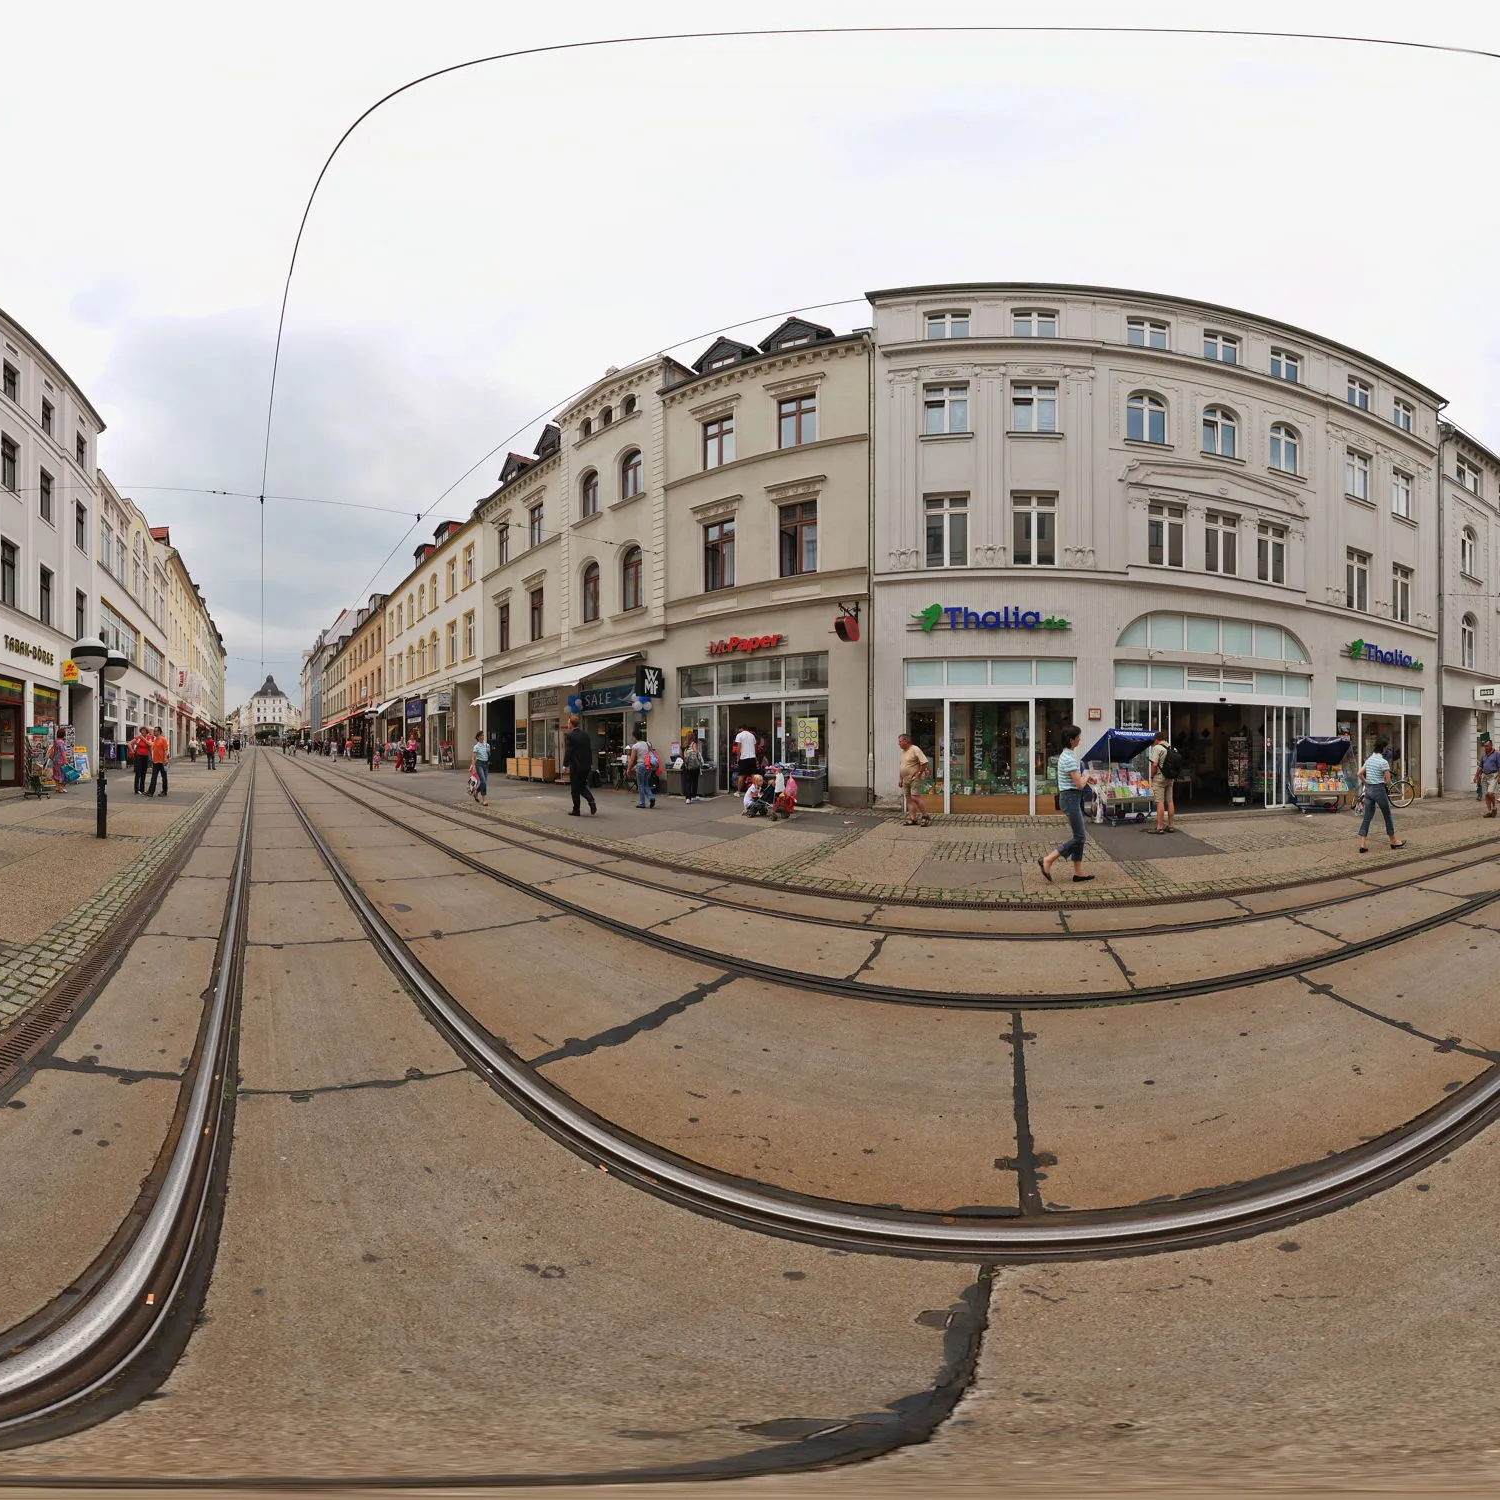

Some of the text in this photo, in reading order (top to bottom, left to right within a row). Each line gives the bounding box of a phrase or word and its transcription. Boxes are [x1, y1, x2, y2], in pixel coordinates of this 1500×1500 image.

[4, 634, 55, 667] TABAK-BÖRSE
[708, 634, 781, 655] McPaper
[585, 691, 612, 708] SALE
